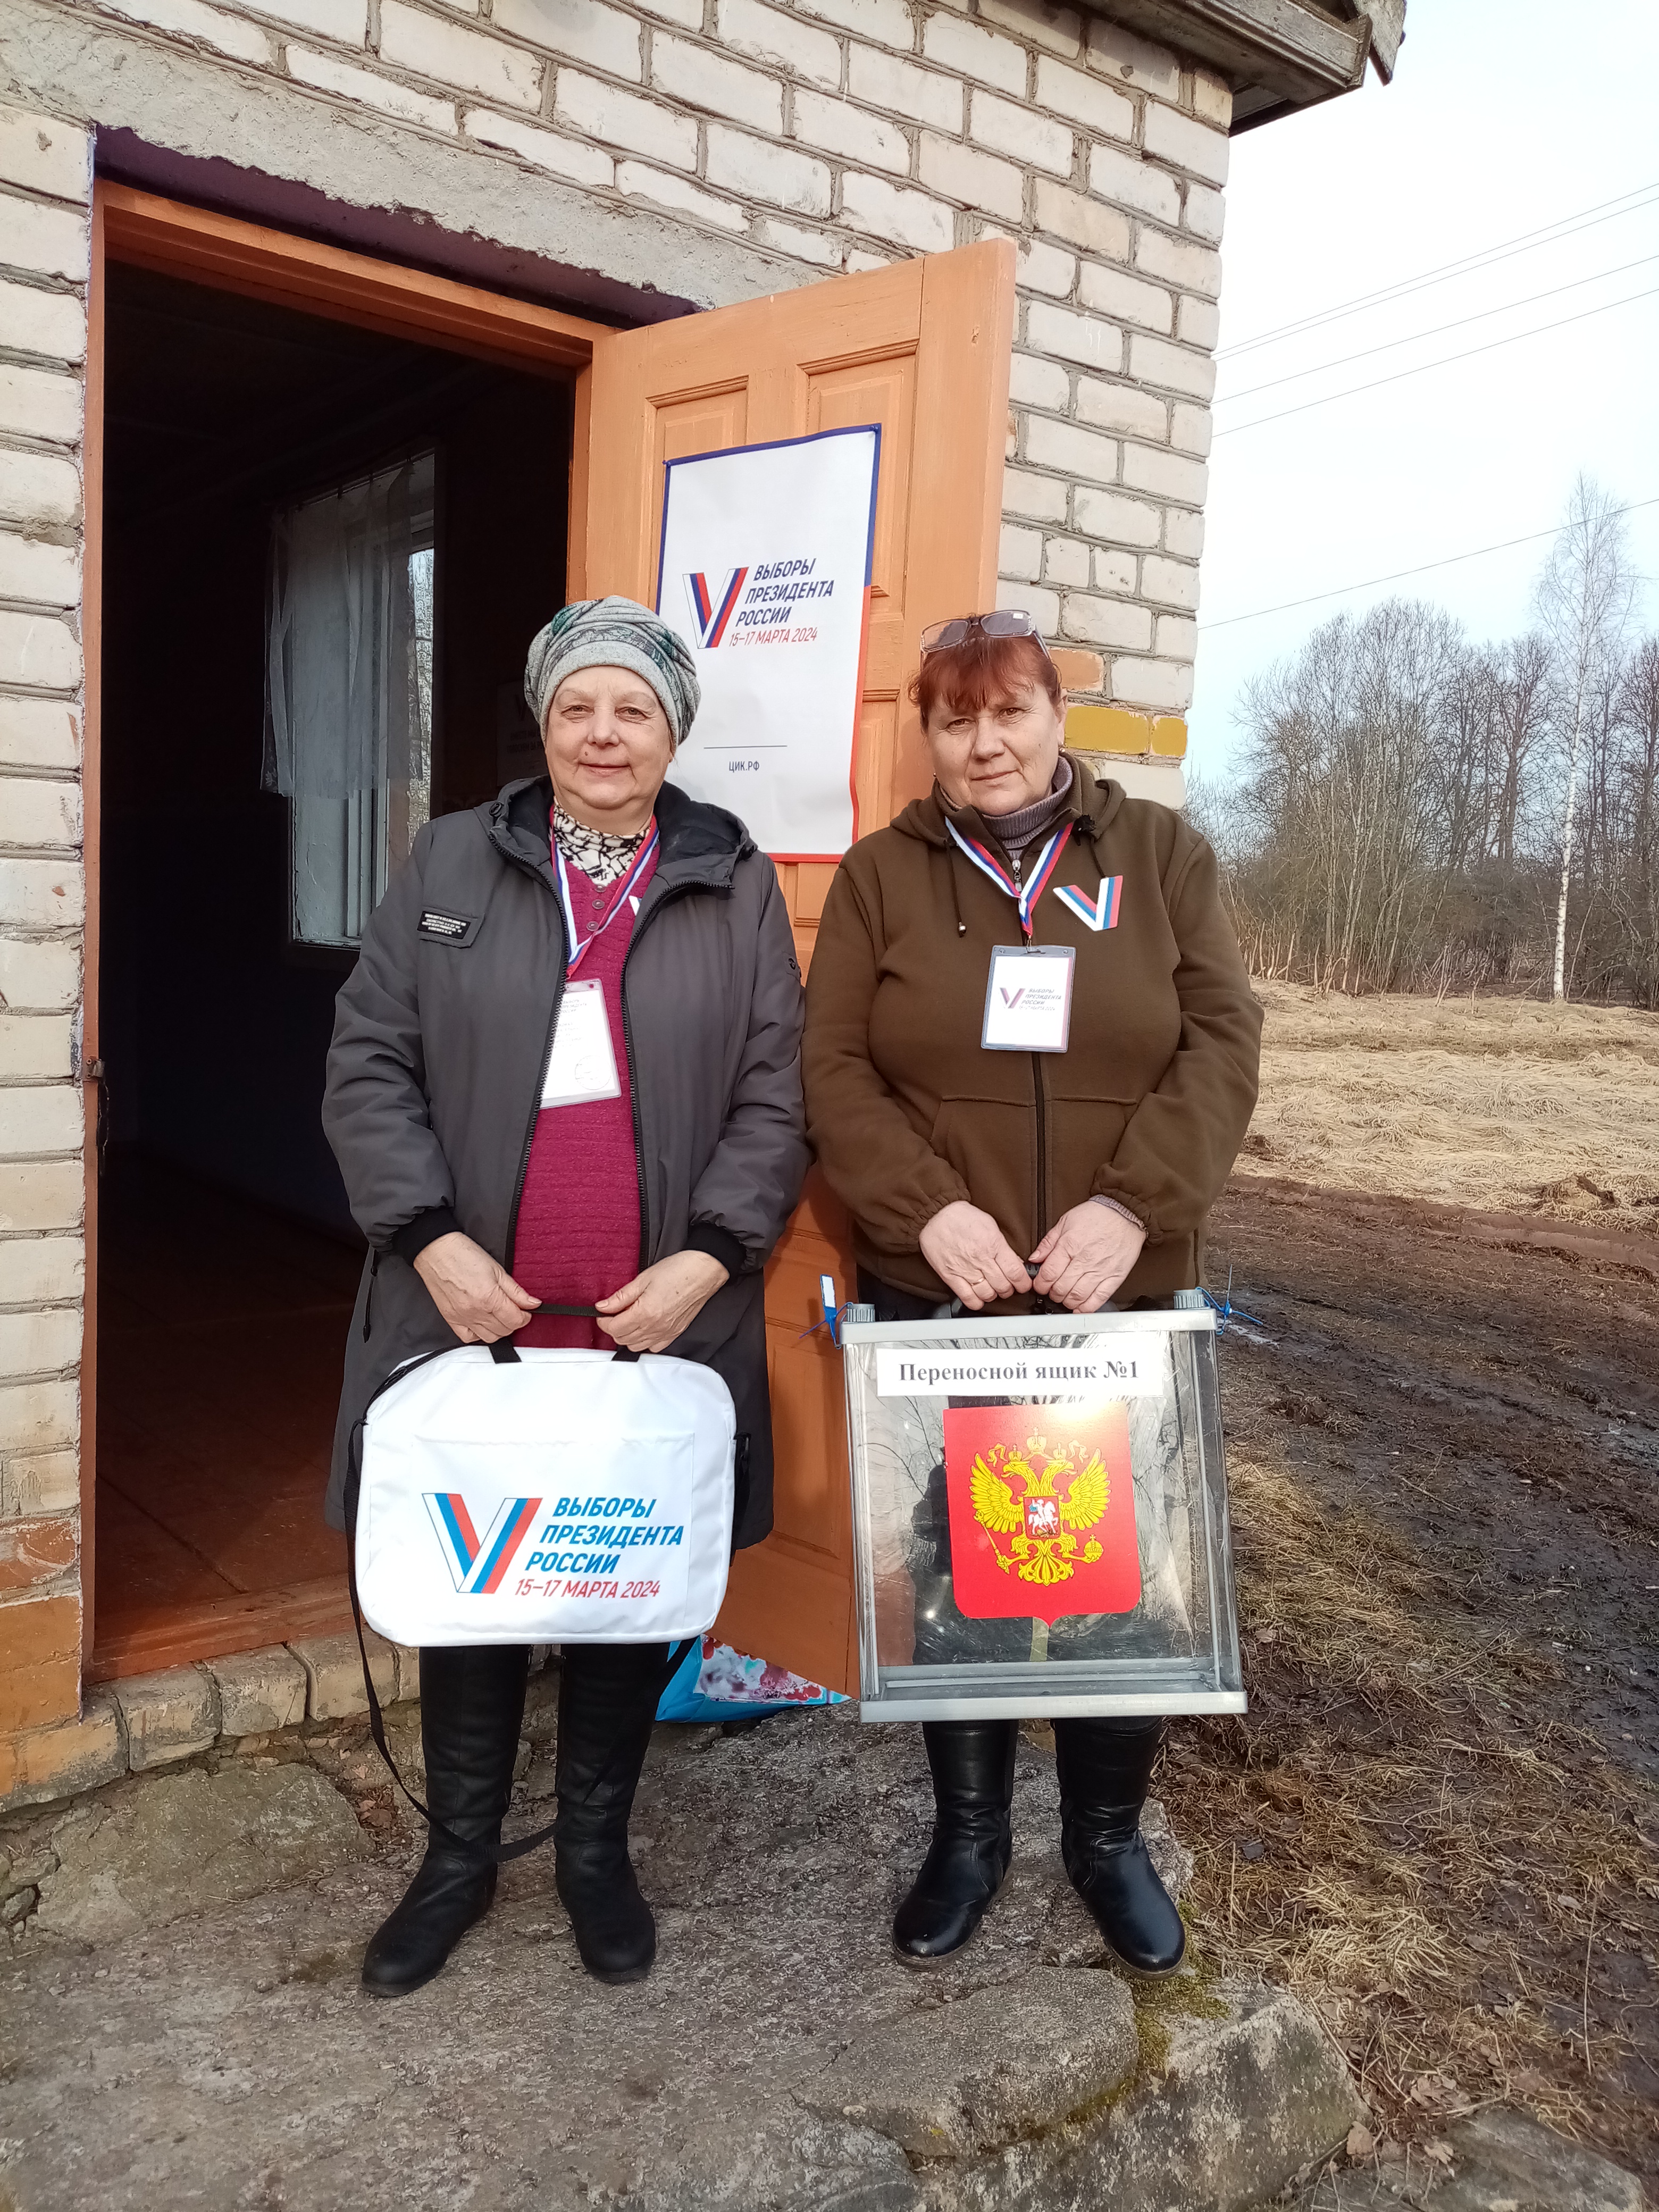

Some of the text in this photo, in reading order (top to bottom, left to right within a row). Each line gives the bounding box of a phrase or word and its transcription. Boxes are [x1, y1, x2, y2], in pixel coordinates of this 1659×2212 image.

[753, 558, 817, 581] ВЫБОРЫ
[744, 580, 835, 605] ПРЕЗИДЕНТА
[735, 606, 792, 627] РОССИИ
[755, 629, 791, 645] МАРТА
[791, 627, 818, 643] 2024
[728, 760, 760, 773] ЦИК.РФ
[899, 1361, 1139, 1385] Переносной ящик №1
[552, 1497, 657, 1518] ВЫБОРЫ
[539, 1524, 684, 1549] ПРЕЗИДЕНТА
[524, 1552, 622, 1574] РОССИИ
[561, 1580, 619, 1598] МАРТА
[620, 1580, 660, 1599] 2024
